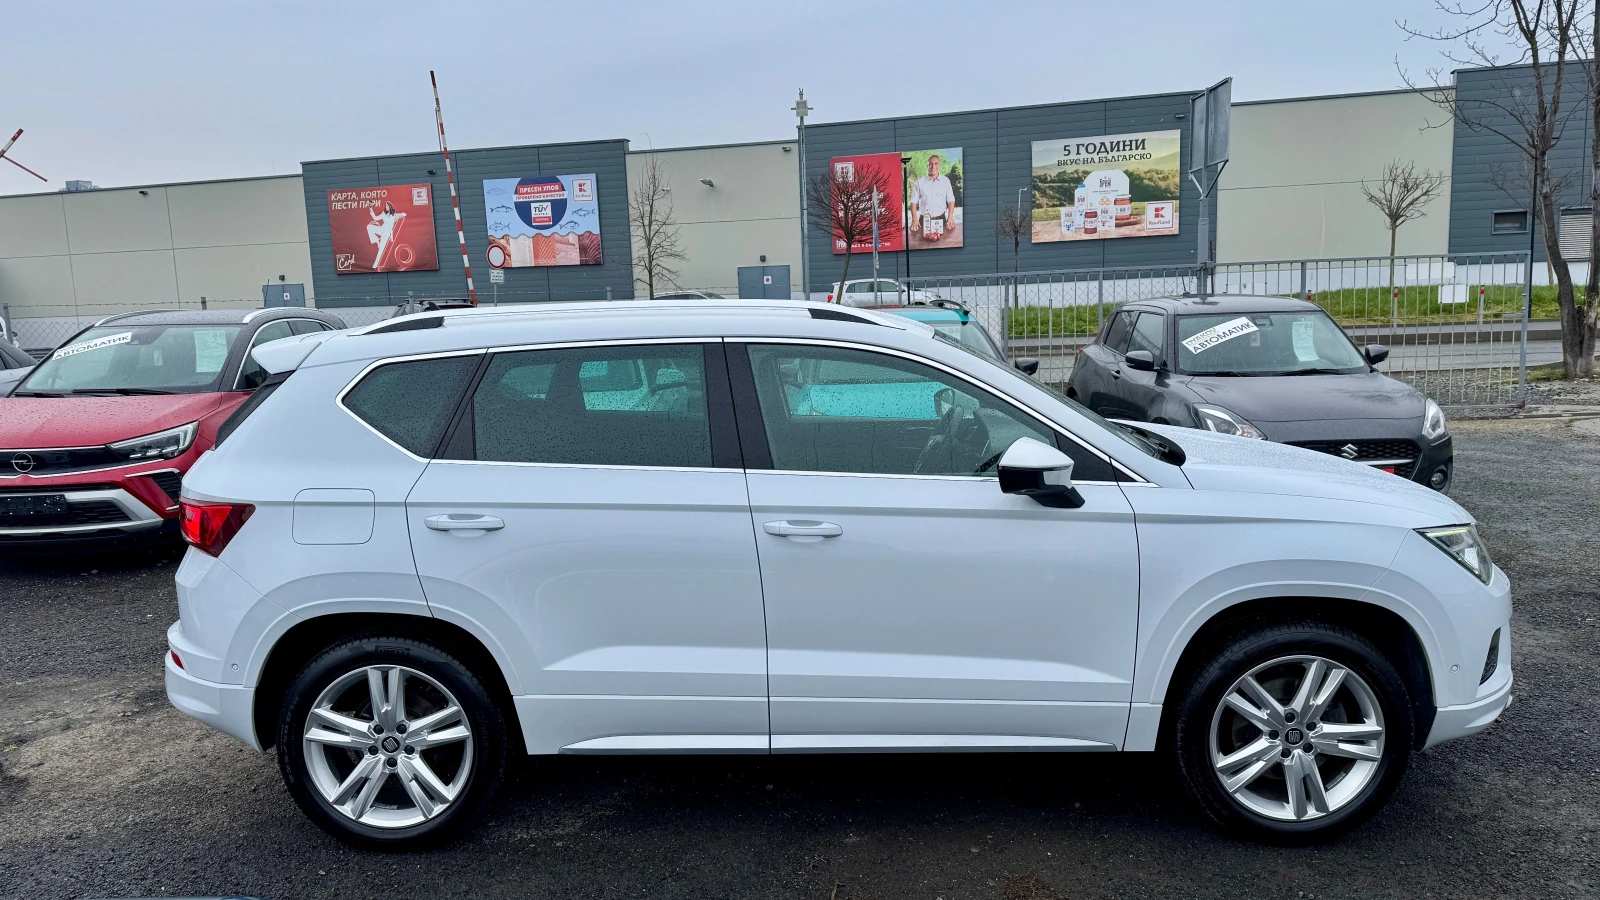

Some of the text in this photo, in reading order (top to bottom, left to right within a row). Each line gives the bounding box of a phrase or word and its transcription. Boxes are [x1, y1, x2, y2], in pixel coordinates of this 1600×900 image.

[1063, 138, 1147, 156] 5 ГОДИНИ
[1057, 152, 1152, 167] ВКУС НА БЪЛГАРСКО
[331, 190, 388, 201] КАРТА, КОЯТО
[543, 184, 559, 192] УЛОВ
[332, 201, 358, 210] ПЕСТИ
[1192, 321, 1254, 353] АВТОМАТИК
[55, 335, 129, 359] АВТОМАТИК
